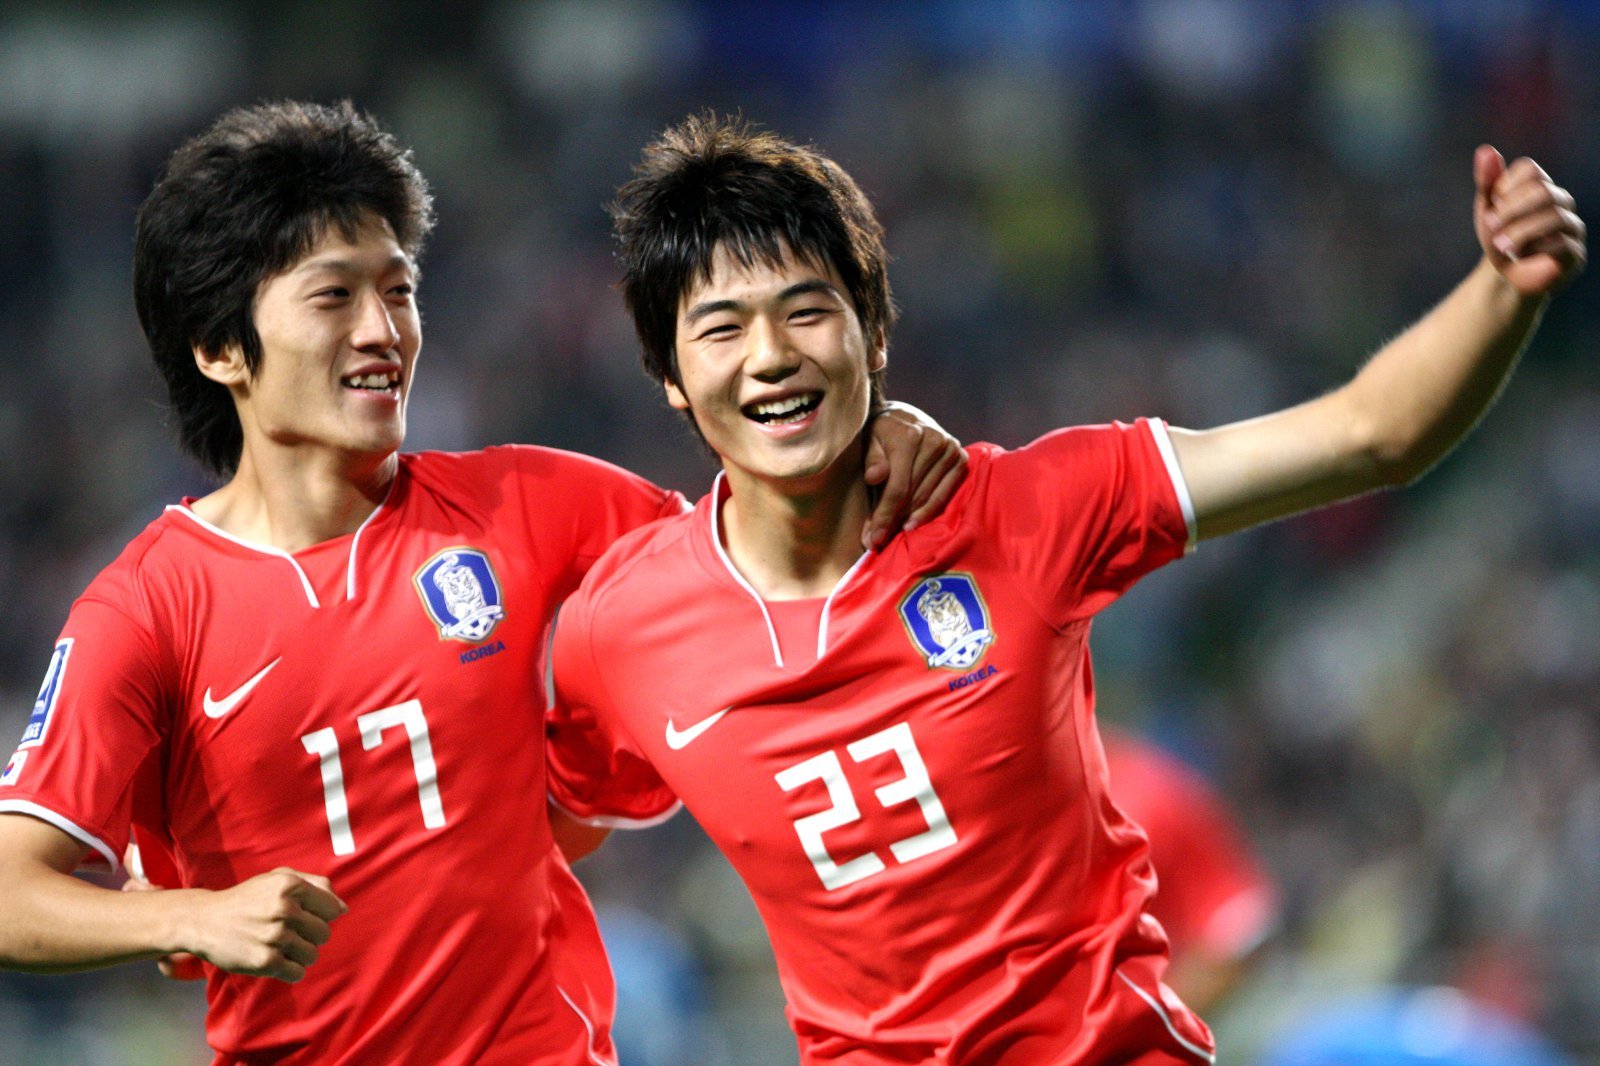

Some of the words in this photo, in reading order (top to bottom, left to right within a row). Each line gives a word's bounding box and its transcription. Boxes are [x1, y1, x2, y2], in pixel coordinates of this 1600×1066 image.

[460, 641, 506, 664] KOREA
[949, 665, 998, 691] KOREA
[301, 698, 446, 856] 17
[774, 722, 958, 891] 23
